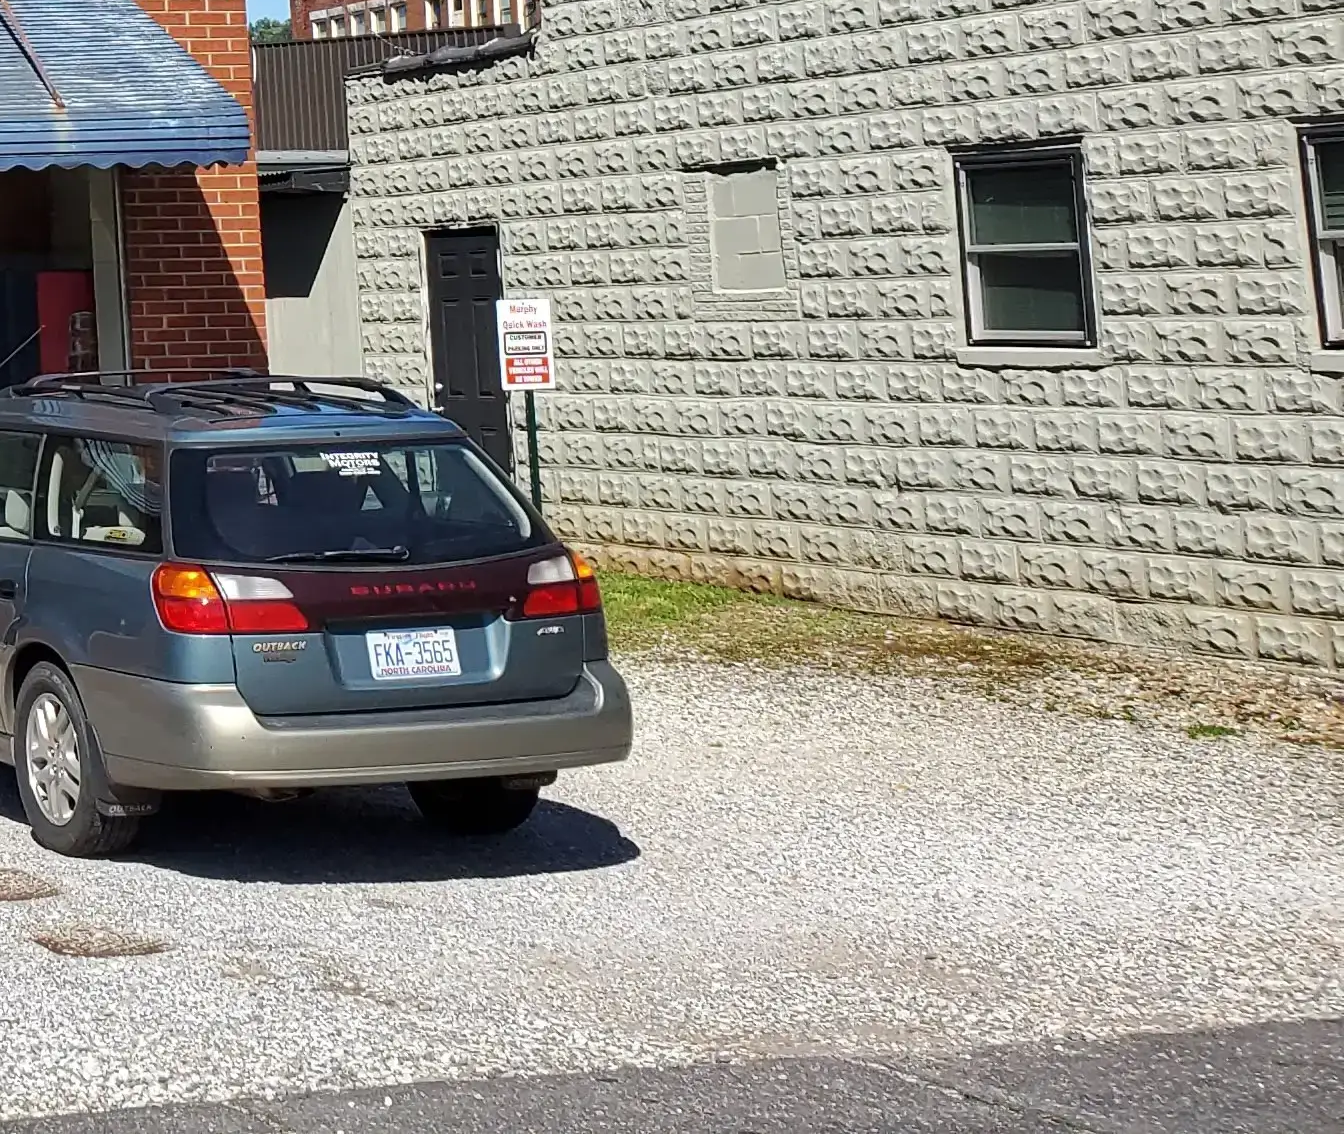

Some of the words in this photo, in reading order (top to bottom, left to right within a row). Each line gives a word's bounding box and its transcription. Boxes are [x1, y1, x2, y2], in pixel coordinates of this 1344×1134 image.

[509, 305, 538, 315] Murphy
[503, 321, 524, 330] Quick
[526, 320, 547, 329] Wash
[319, 452, 379, 461] INTEGRITY
[328, 459, 381, 468] MOTORS
[350, 581, 476, 596] SUBARU
[253, 640, 307, 652] OUTBACK
[373, 640, 454, 667] FKA-3565
[381, 667, 410, 676] NORTH
[411, 665, 452, 674] CAROLINA
